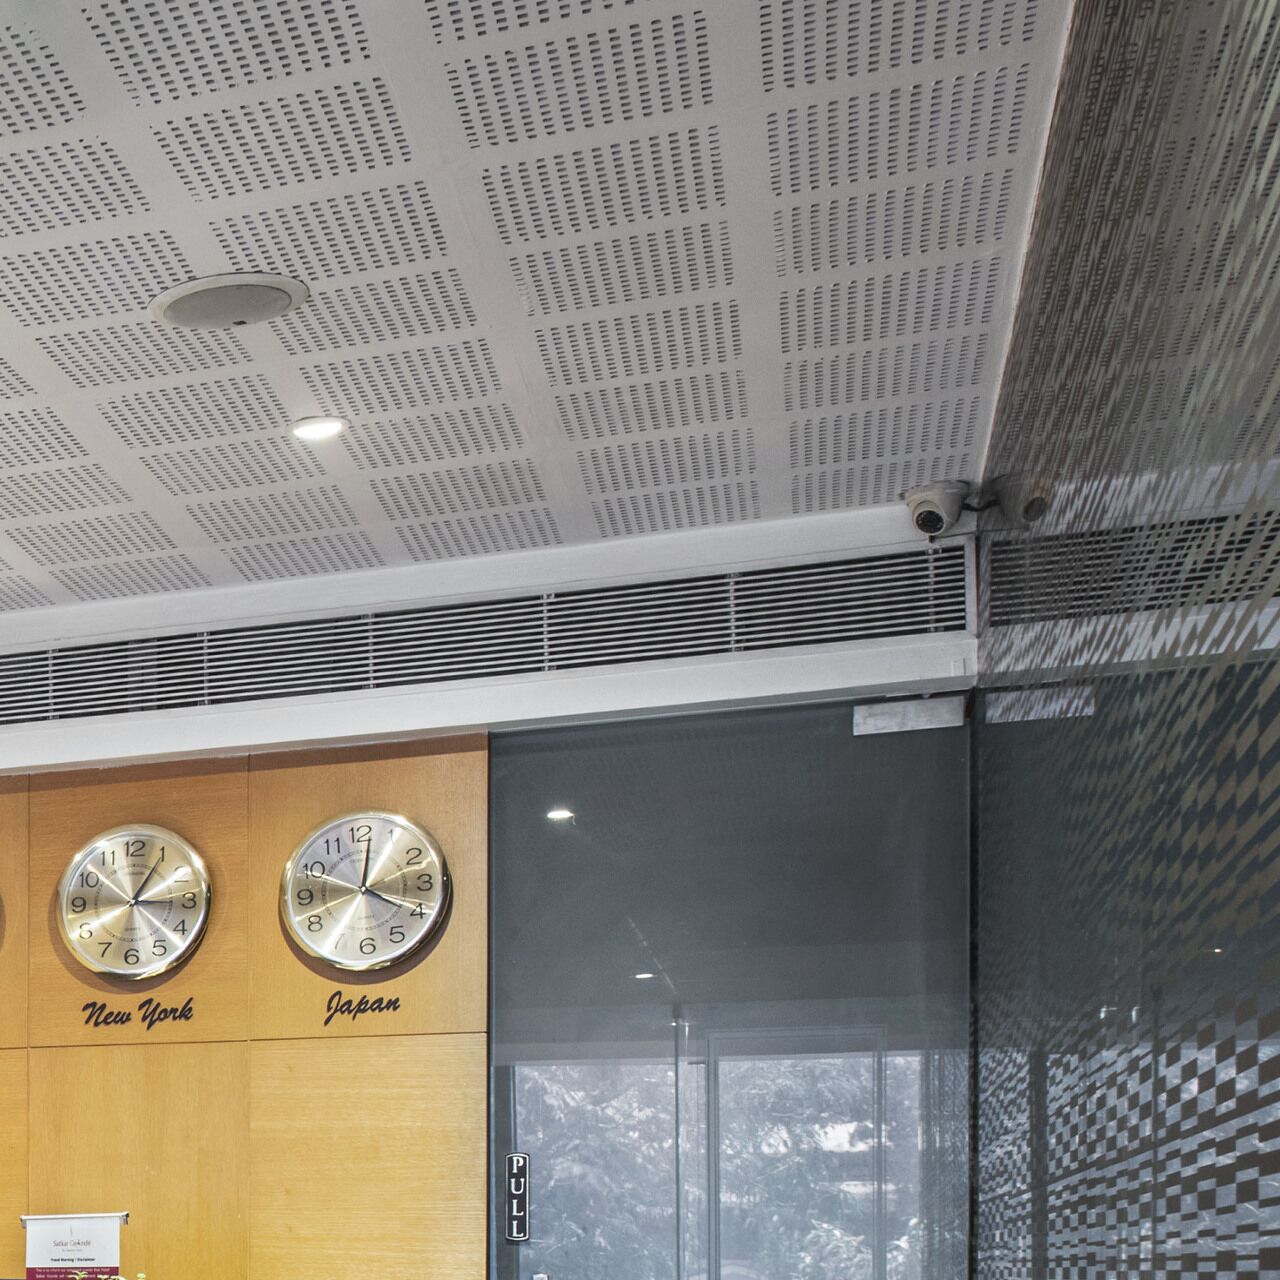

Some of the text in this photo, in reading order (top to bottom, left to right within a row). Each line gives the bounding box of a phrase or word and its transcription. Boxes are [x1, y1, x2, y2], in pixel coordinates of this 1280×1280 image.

[348, 825, 372, 843] 12
[125, 840, 145, 857] 12
[159, 846, 165, 862] 1
[324, 838, 341, 855] 11
[100, 850, 115, 866] 11
[406, 848, 422, 865] 2
[303, 861, 325, 879] 10
[79, 871, 99, 888] 10
[417, 873, 433, 891] 3
[71, 896, 86, 913] 9
[182, 891, 197, 909] 3
[297, 888, 313, 906] 9
[410, 902, 426, 919] 4
[79, 923, 93, 939] 8
[173, 919, 188, 935] 4
[308, 915, 323, 932] 8
[389, 926, 405, 943] 5
[98, 942, 112, 958] 7
[151, 939, 167, 956] 5
[359, 938, 376, 955] 6
[124, 948, 139, 965] 6
[82, 997, 193, 1030] New York
[324, 990, 400, 1026] Japan
[510, 1156, 525, 1237] PULL
